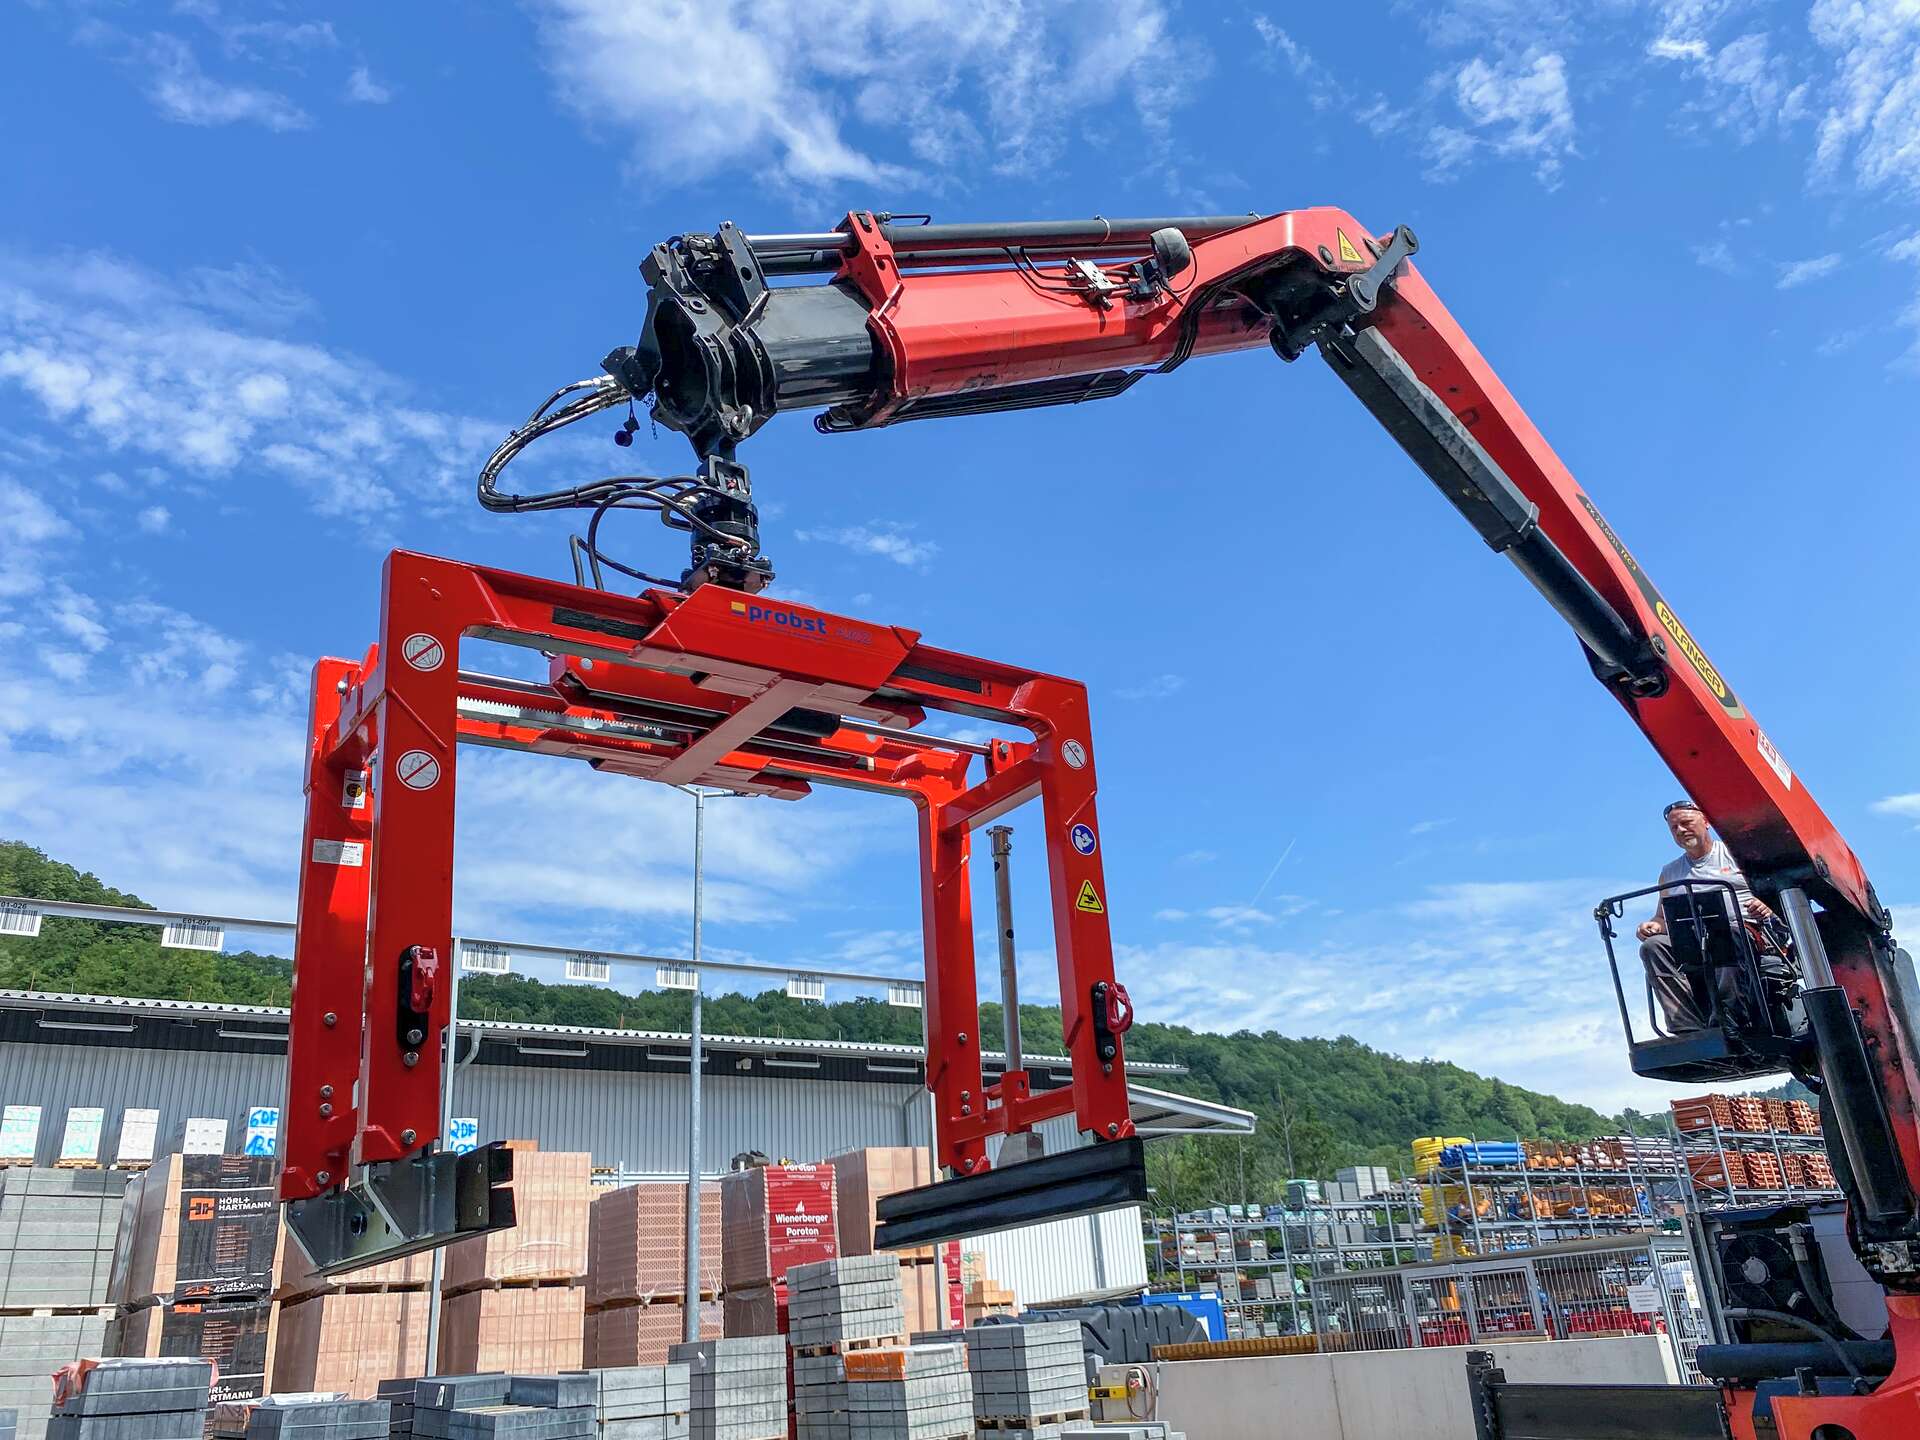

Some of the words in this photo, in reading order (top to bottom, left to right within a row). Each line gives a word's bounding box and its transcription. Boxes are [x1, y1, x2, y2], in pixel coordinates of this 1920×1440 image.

[748, 604, 827, 634] probst
[1660, 607, 1721, 692] PALFINGER
[0, 900, 27, 909] 01-026
[183, 917, 211, 925] E01-027
[218, 1197, 250, 1205] HÖRL+
[218, 1201, 272, 1211] HARTMANN
[775, 1213, 829, 1224] Wienerberger
[786, 1226, 819, 1237] Poroton
